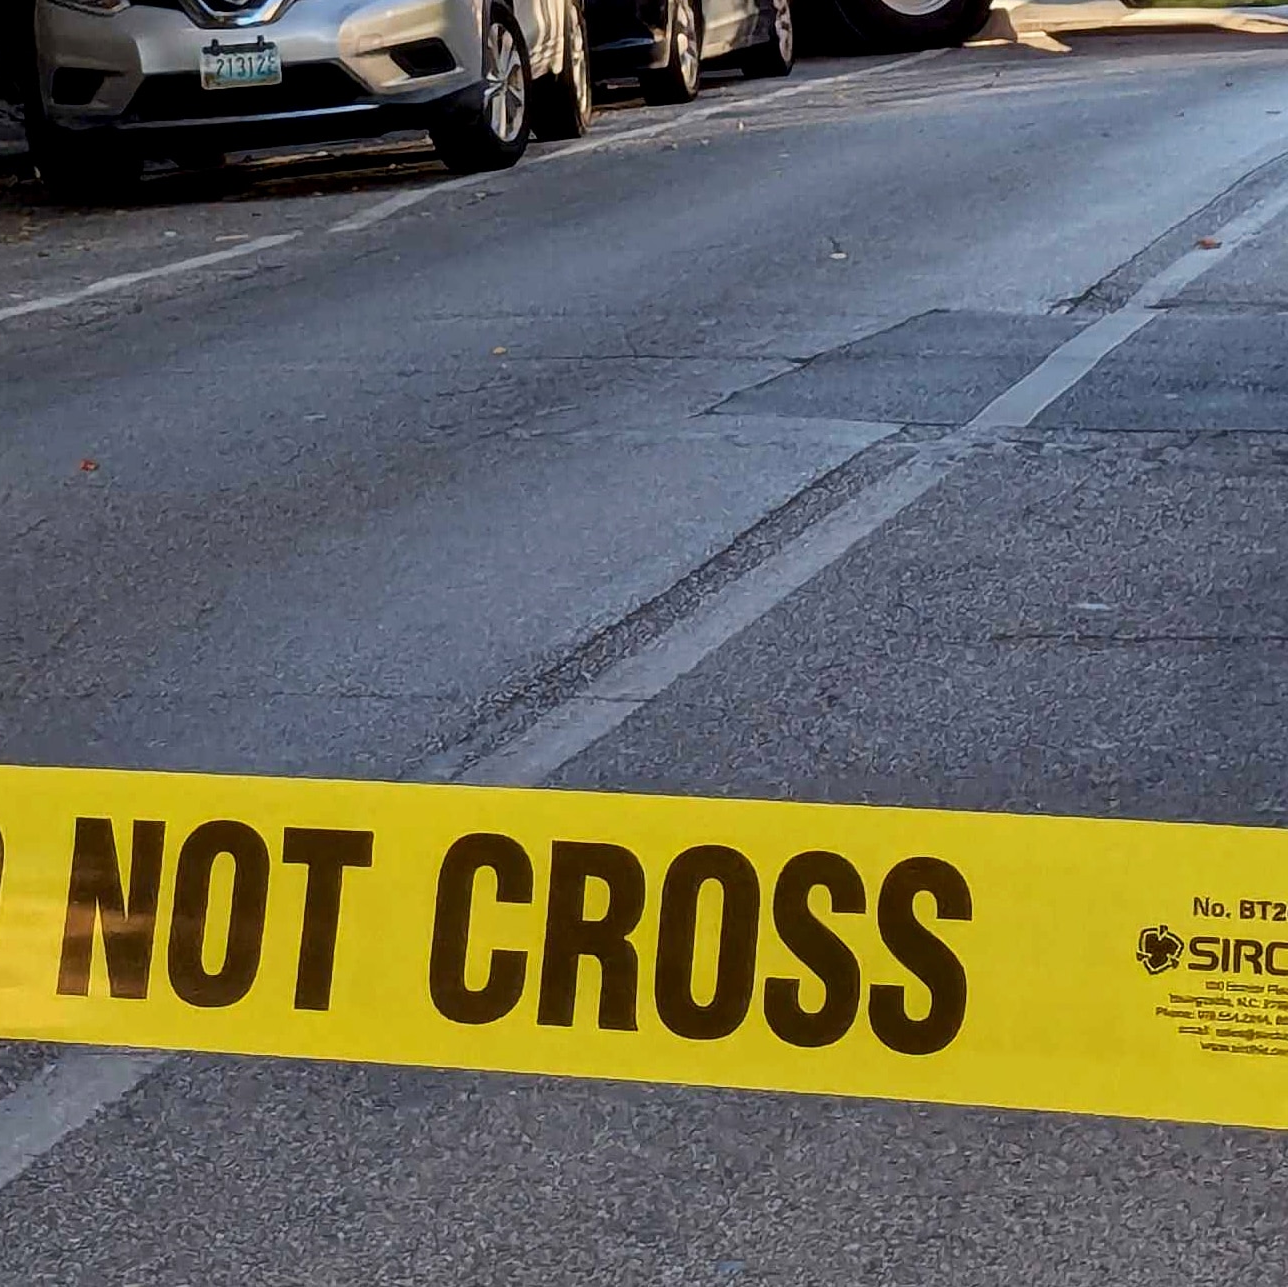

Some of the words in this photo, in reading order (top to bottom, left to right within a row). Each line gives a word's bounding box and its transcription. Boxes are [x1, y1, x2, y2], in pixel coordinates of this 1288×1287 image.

[57, 816, 374, 1012] NOT
[429, 832, 973, 1056] CROSS
[1192, 896, 1232, 919] No.
